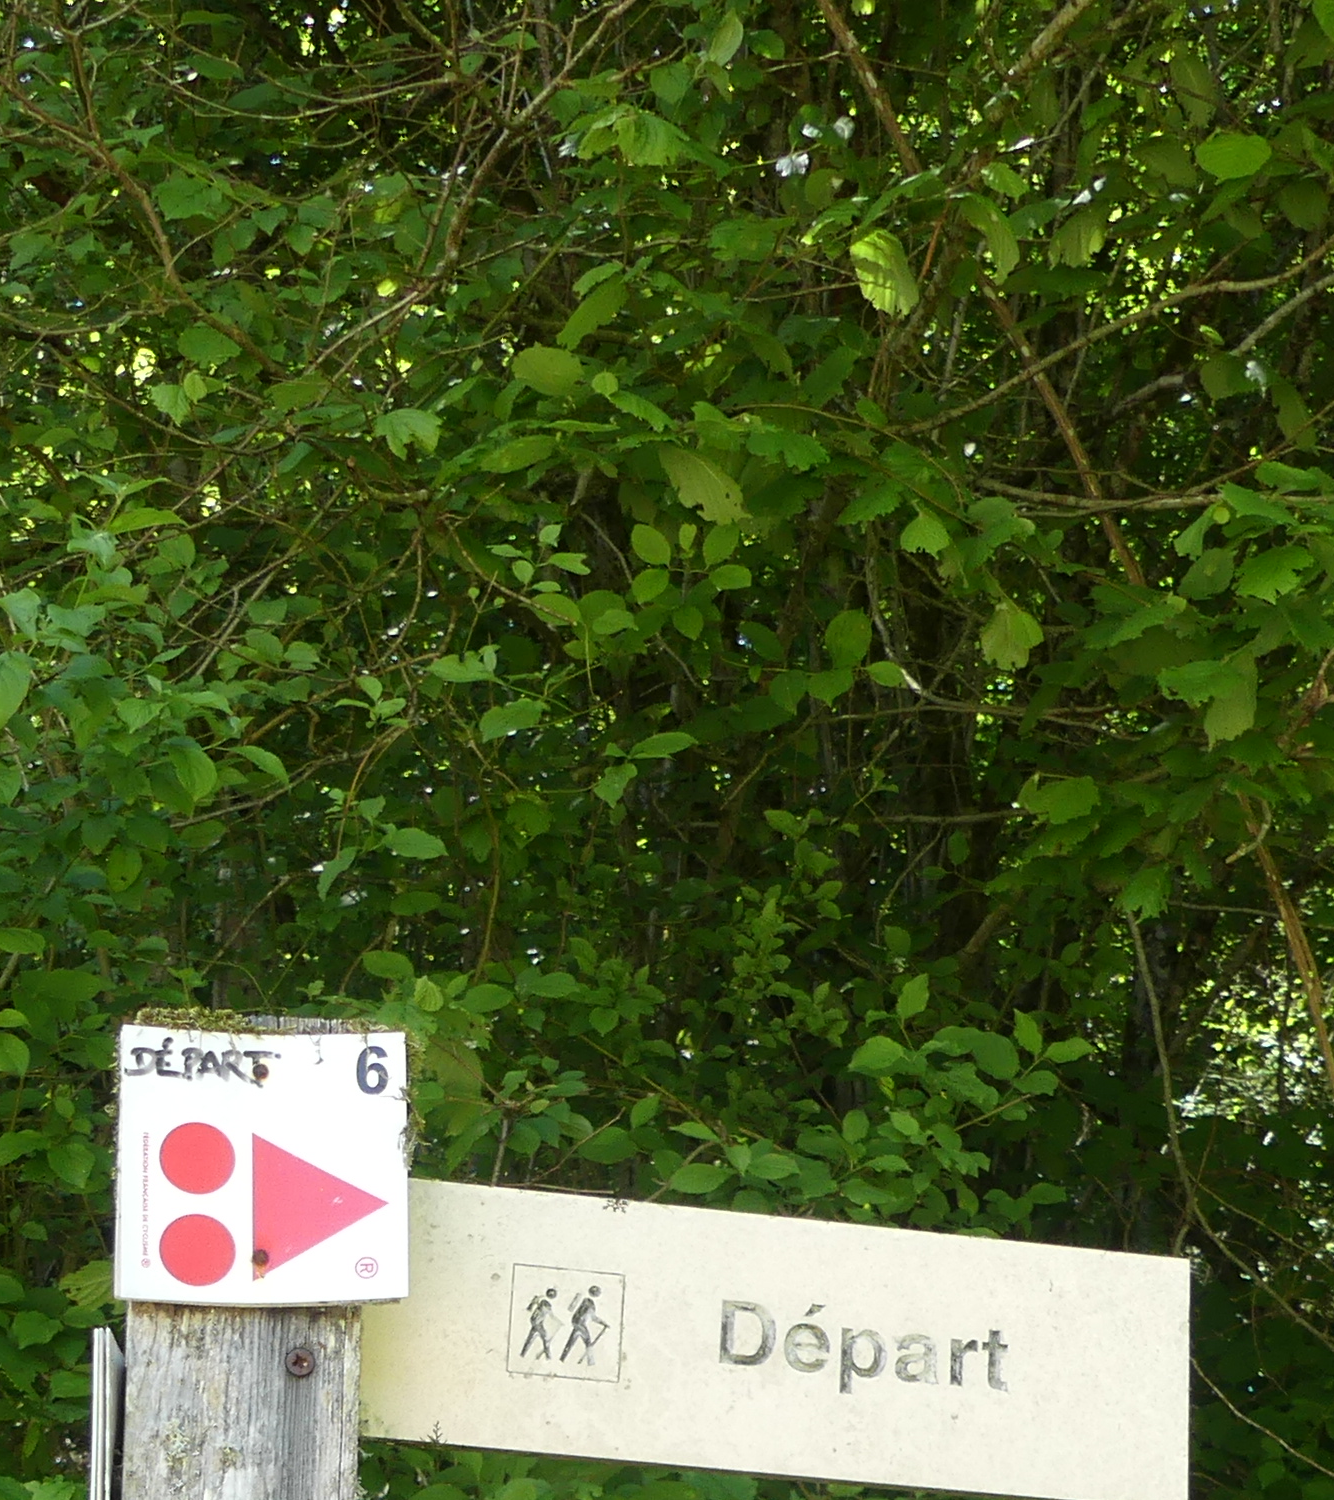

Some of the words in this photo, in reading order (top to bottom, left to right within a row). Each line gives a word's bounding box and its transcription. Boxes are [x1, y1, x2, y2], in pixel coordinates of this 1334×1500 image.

[124, 1037, 281, 1088] DÉPART
[356, 1046, 389, 1095] 6
[719, 1299, 1010, 1395] Départ
